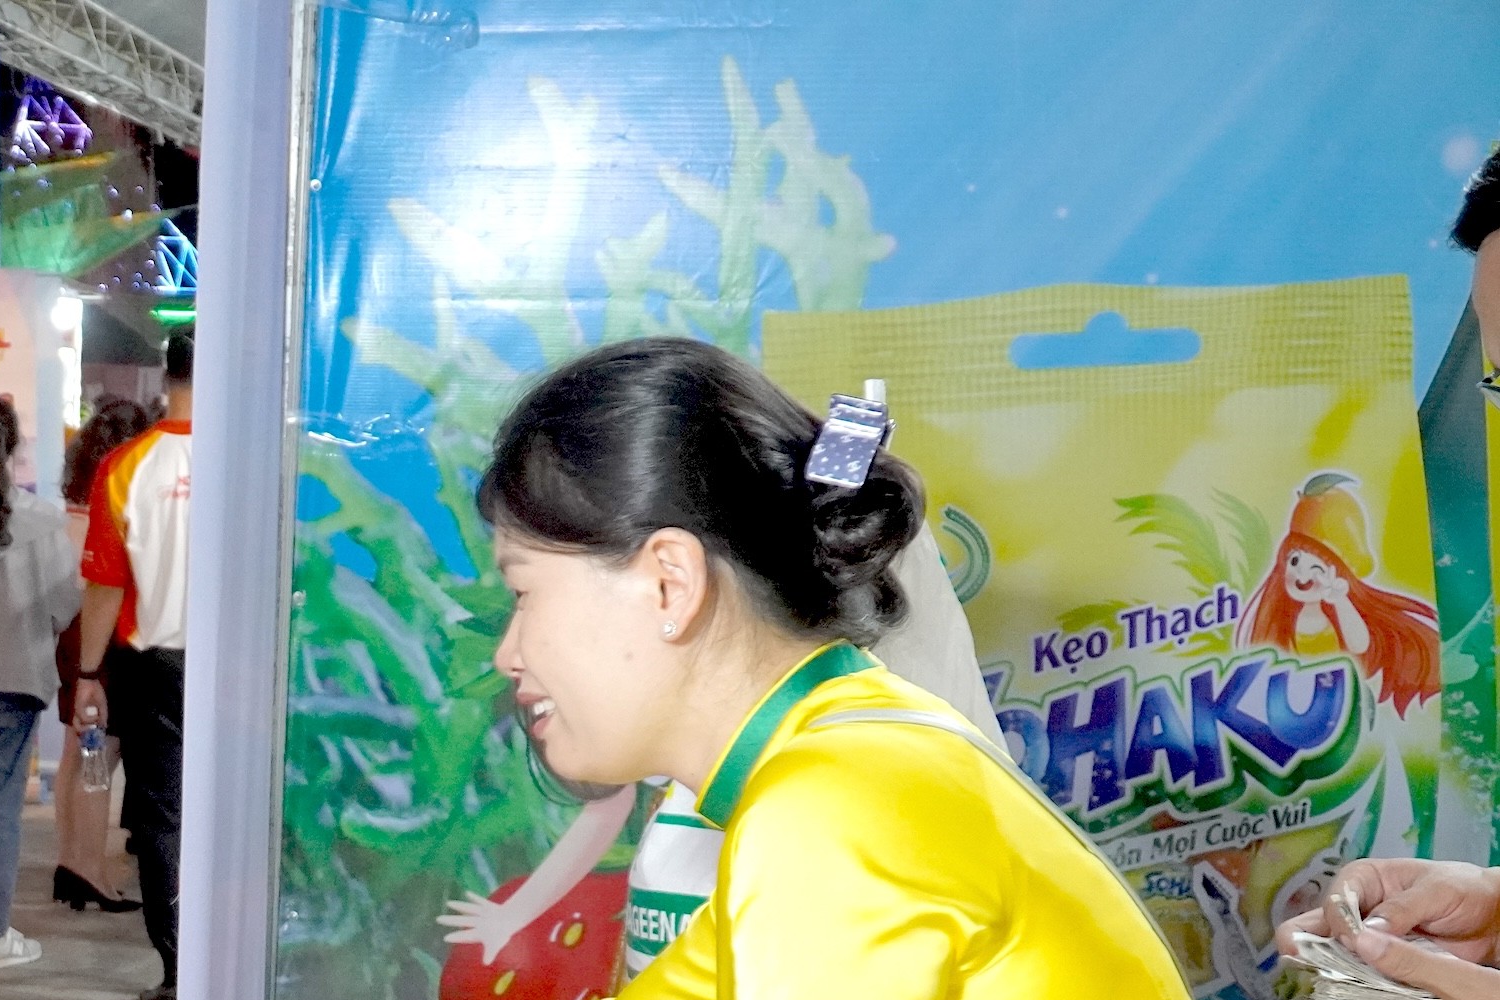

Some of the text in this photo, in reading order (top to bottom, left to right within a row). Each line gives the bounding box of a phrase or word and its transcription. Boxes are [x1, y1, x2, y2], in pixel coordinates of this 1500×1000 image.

[1034, 586, 1239, 675] Kẹo Thạch
[983, 658, 1346, 812] OHAKU
[1151, 829, 1198, 859] Mọi
[1205, 817, 1265, 845] Cuộc
[1271, 802, 1308, 830] Vui
